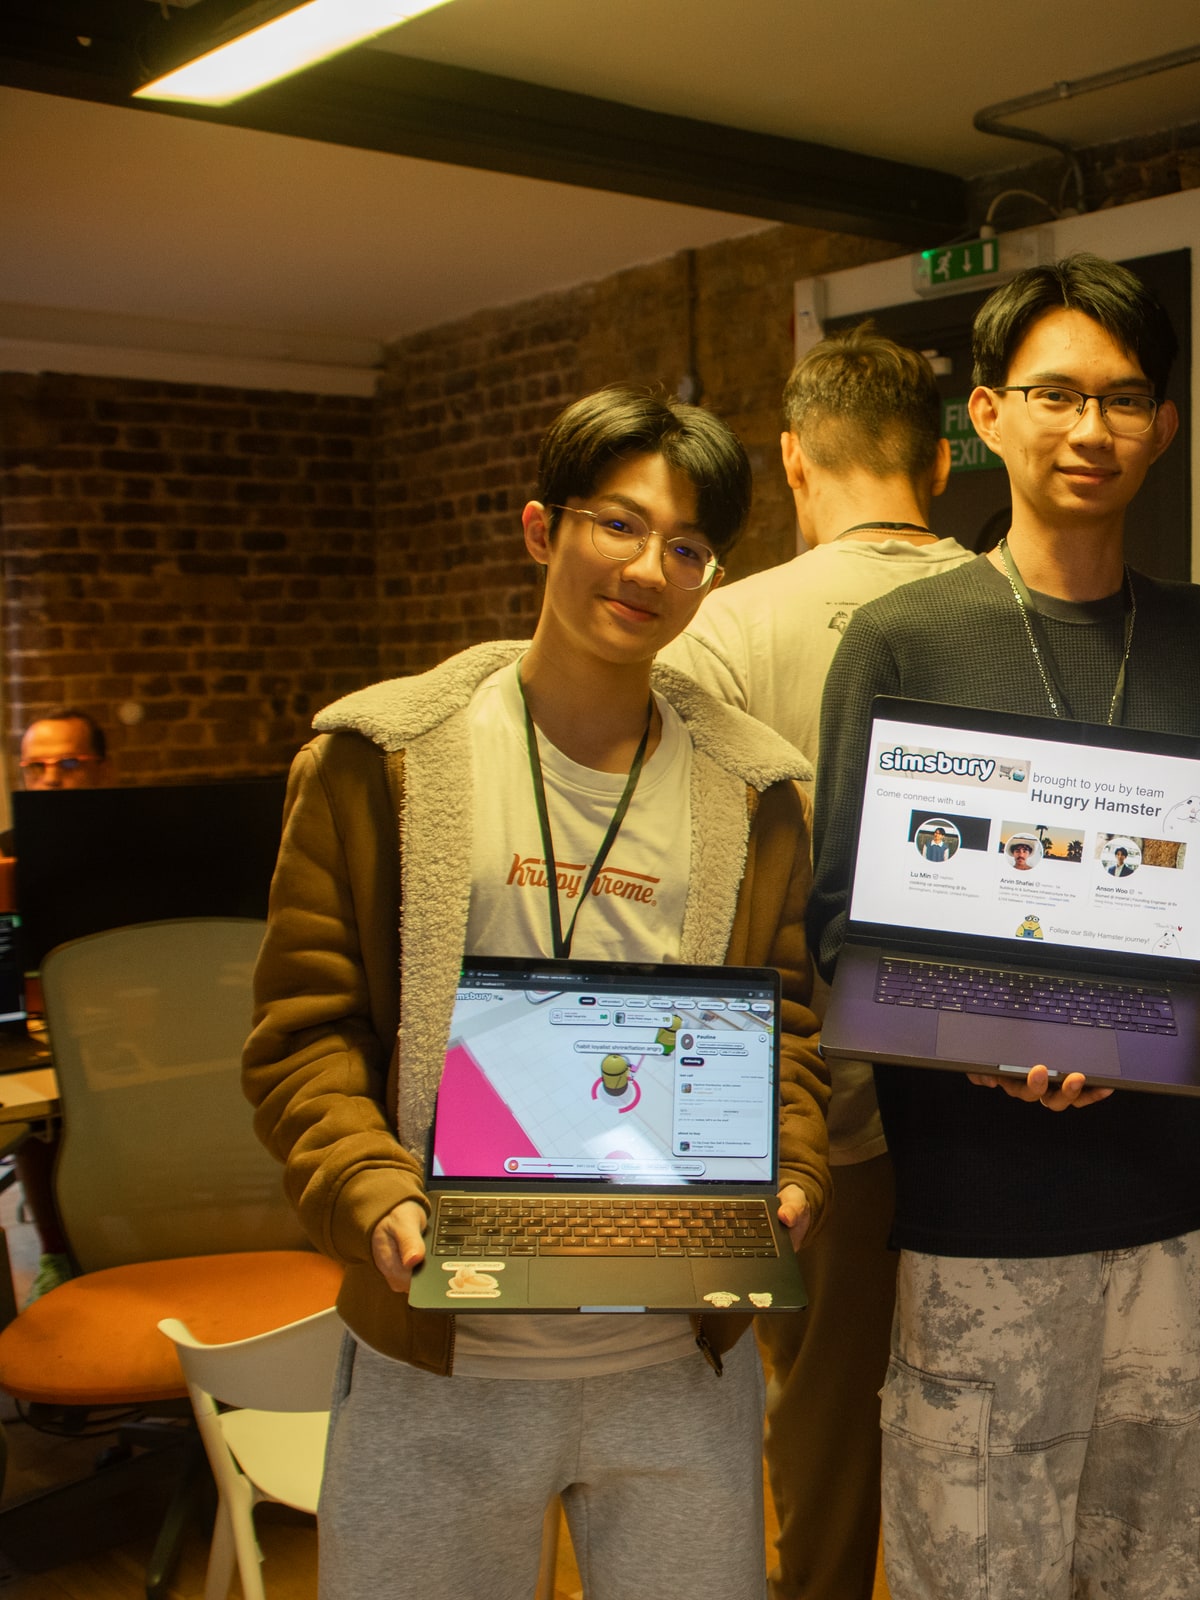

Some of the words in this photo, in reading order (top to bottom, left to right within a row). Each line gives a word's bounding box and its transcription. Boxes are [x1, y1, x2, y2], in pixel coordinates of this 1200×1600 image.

[880, 747, 996, 782] simsbury
[1032, 772, 1077, 788] brought
[1080, 779, 1091, 789] to
[1094, 782, 1116, 793] you
[1119, 784, 1133, 796] by
[1136, 786, 1165, 799] team
[876, 788, 901, 799] Come
[903, 791, 936, 802] connect
[938, 795, 953, 805] with
[956, 799, 966, 807] us
[1031, 789, 1090, 811] Hungry
[1094, 797, 1162, 817] Hamster
[1049, 926, 1070, 934] Follow
[1097, 932, 1123, 941] Hamster
[456, 992, 493, 1002] msbury
